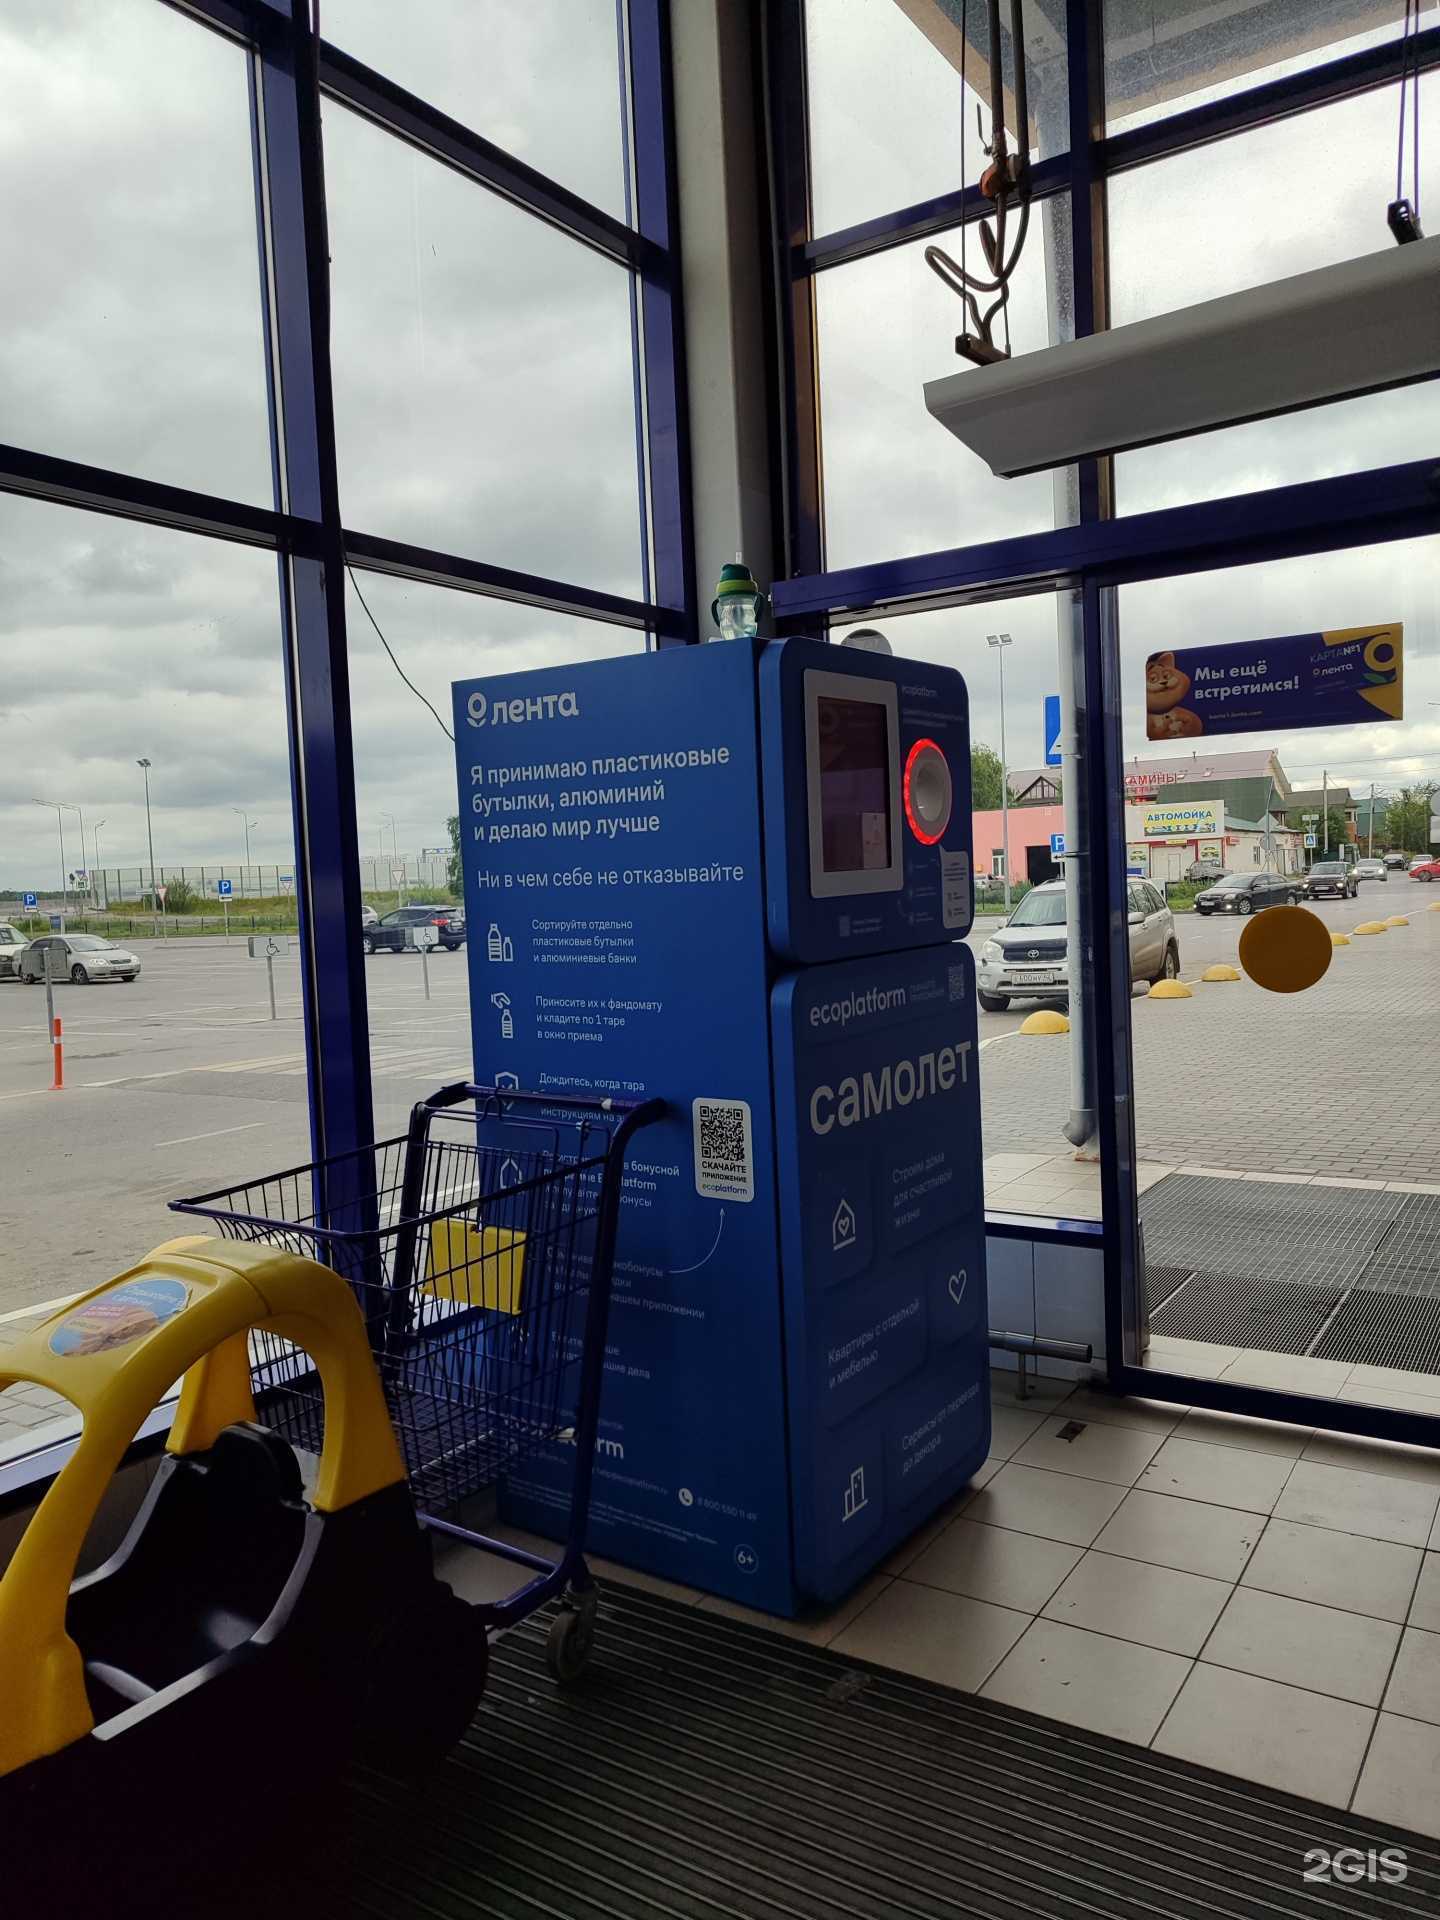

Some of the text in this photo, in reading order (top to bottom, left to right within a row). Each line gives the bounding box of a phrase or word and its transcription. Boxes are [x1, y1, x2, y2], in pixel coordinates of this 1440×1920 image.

[1194, 660, 1267, 681] Мы ещё
[1194, 675, 1299, 701] встретимся!
[491, 691, 579, 726] лента
[471, 746, 730, 788] Я принимаю пластиковые
[472, 780, 665, 817] бутылки, алюминий
[1147, 808, 1213, 822] АВТОМОЙКА
[474, 814, 660, 843] и делаю мир лучше
[478, 863, 744, 888] Ни в чем себе не отказывайте
[222, 881, 230, 893] P
[531, 919, 633, 932] Сортируйте отдельно
[533, 935, 634, 949] пластиковые бутылки
[533, 953, 637, 965] и алюминиевые банки
[535, 996, 663, 1013] Приносите их к фандомату
[810, 986, 906, 1027] ecoplatform
[536, 1013, 625, 1027] и кладите по 1 таре
[537, 1031, 603, 1044] в окно приема
[539, 1072, 645, 1092] Дождитесь, когда тара
[810, 1040, 971, 1135] самолет
[541, 1109, 601, 1122] инструкциям
[631, 1160, 680, 1177] бонусной
[702, 1161, 747, 1174] СКАЧАЙТЕ
[702, 1172, 747, 1183] ПРИЛОЖЕНИЕ
[702, 1183, 747, 1195] ecoplatform
[828, 1331, 874, 1366] Квартиры
[837, 1349, 879, 1384] мебелью
[737, 1551, 754, 1565] 6+
